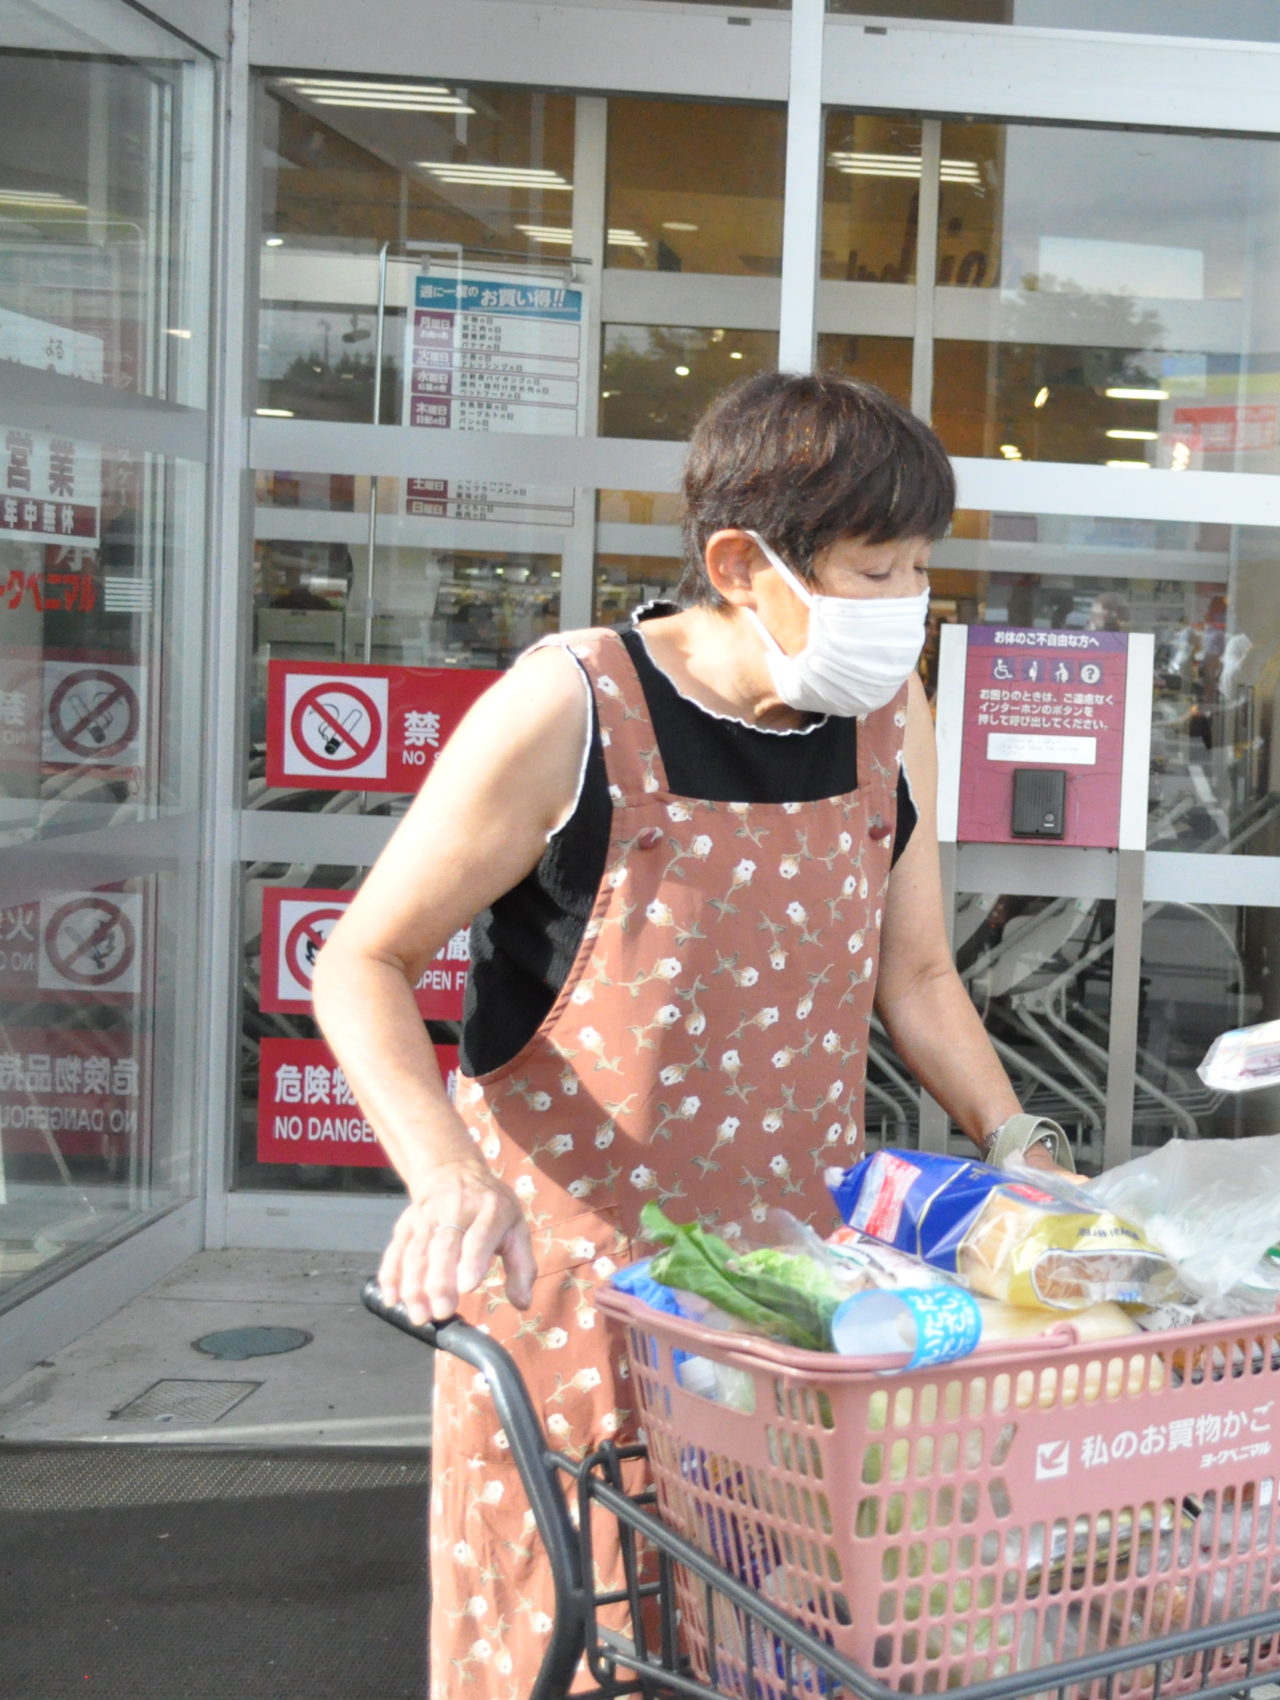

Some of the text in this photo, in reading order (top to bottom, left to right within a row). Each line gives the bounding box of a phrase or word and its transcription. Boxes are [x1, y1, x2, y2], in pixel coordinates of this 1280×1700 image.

[416, 402, 447, 416] 木曜日
[6, 430, 75, 497] 営業
[4, 499, 74, 535] 年中無休
[994, 631, 1100, 648] お体のご不自由な方へ
[979, 701, 1094, 718] インターホンのボタンを
[404, 710, 440, 748] 禁
[402, 750, 426, 766] NO
[274, 1116, 301, 1141] NO
[1081, 1400, 1275, 1468] 私のお買物かご
[1200, 1441, 1272, 1468] ヨークベニマル
